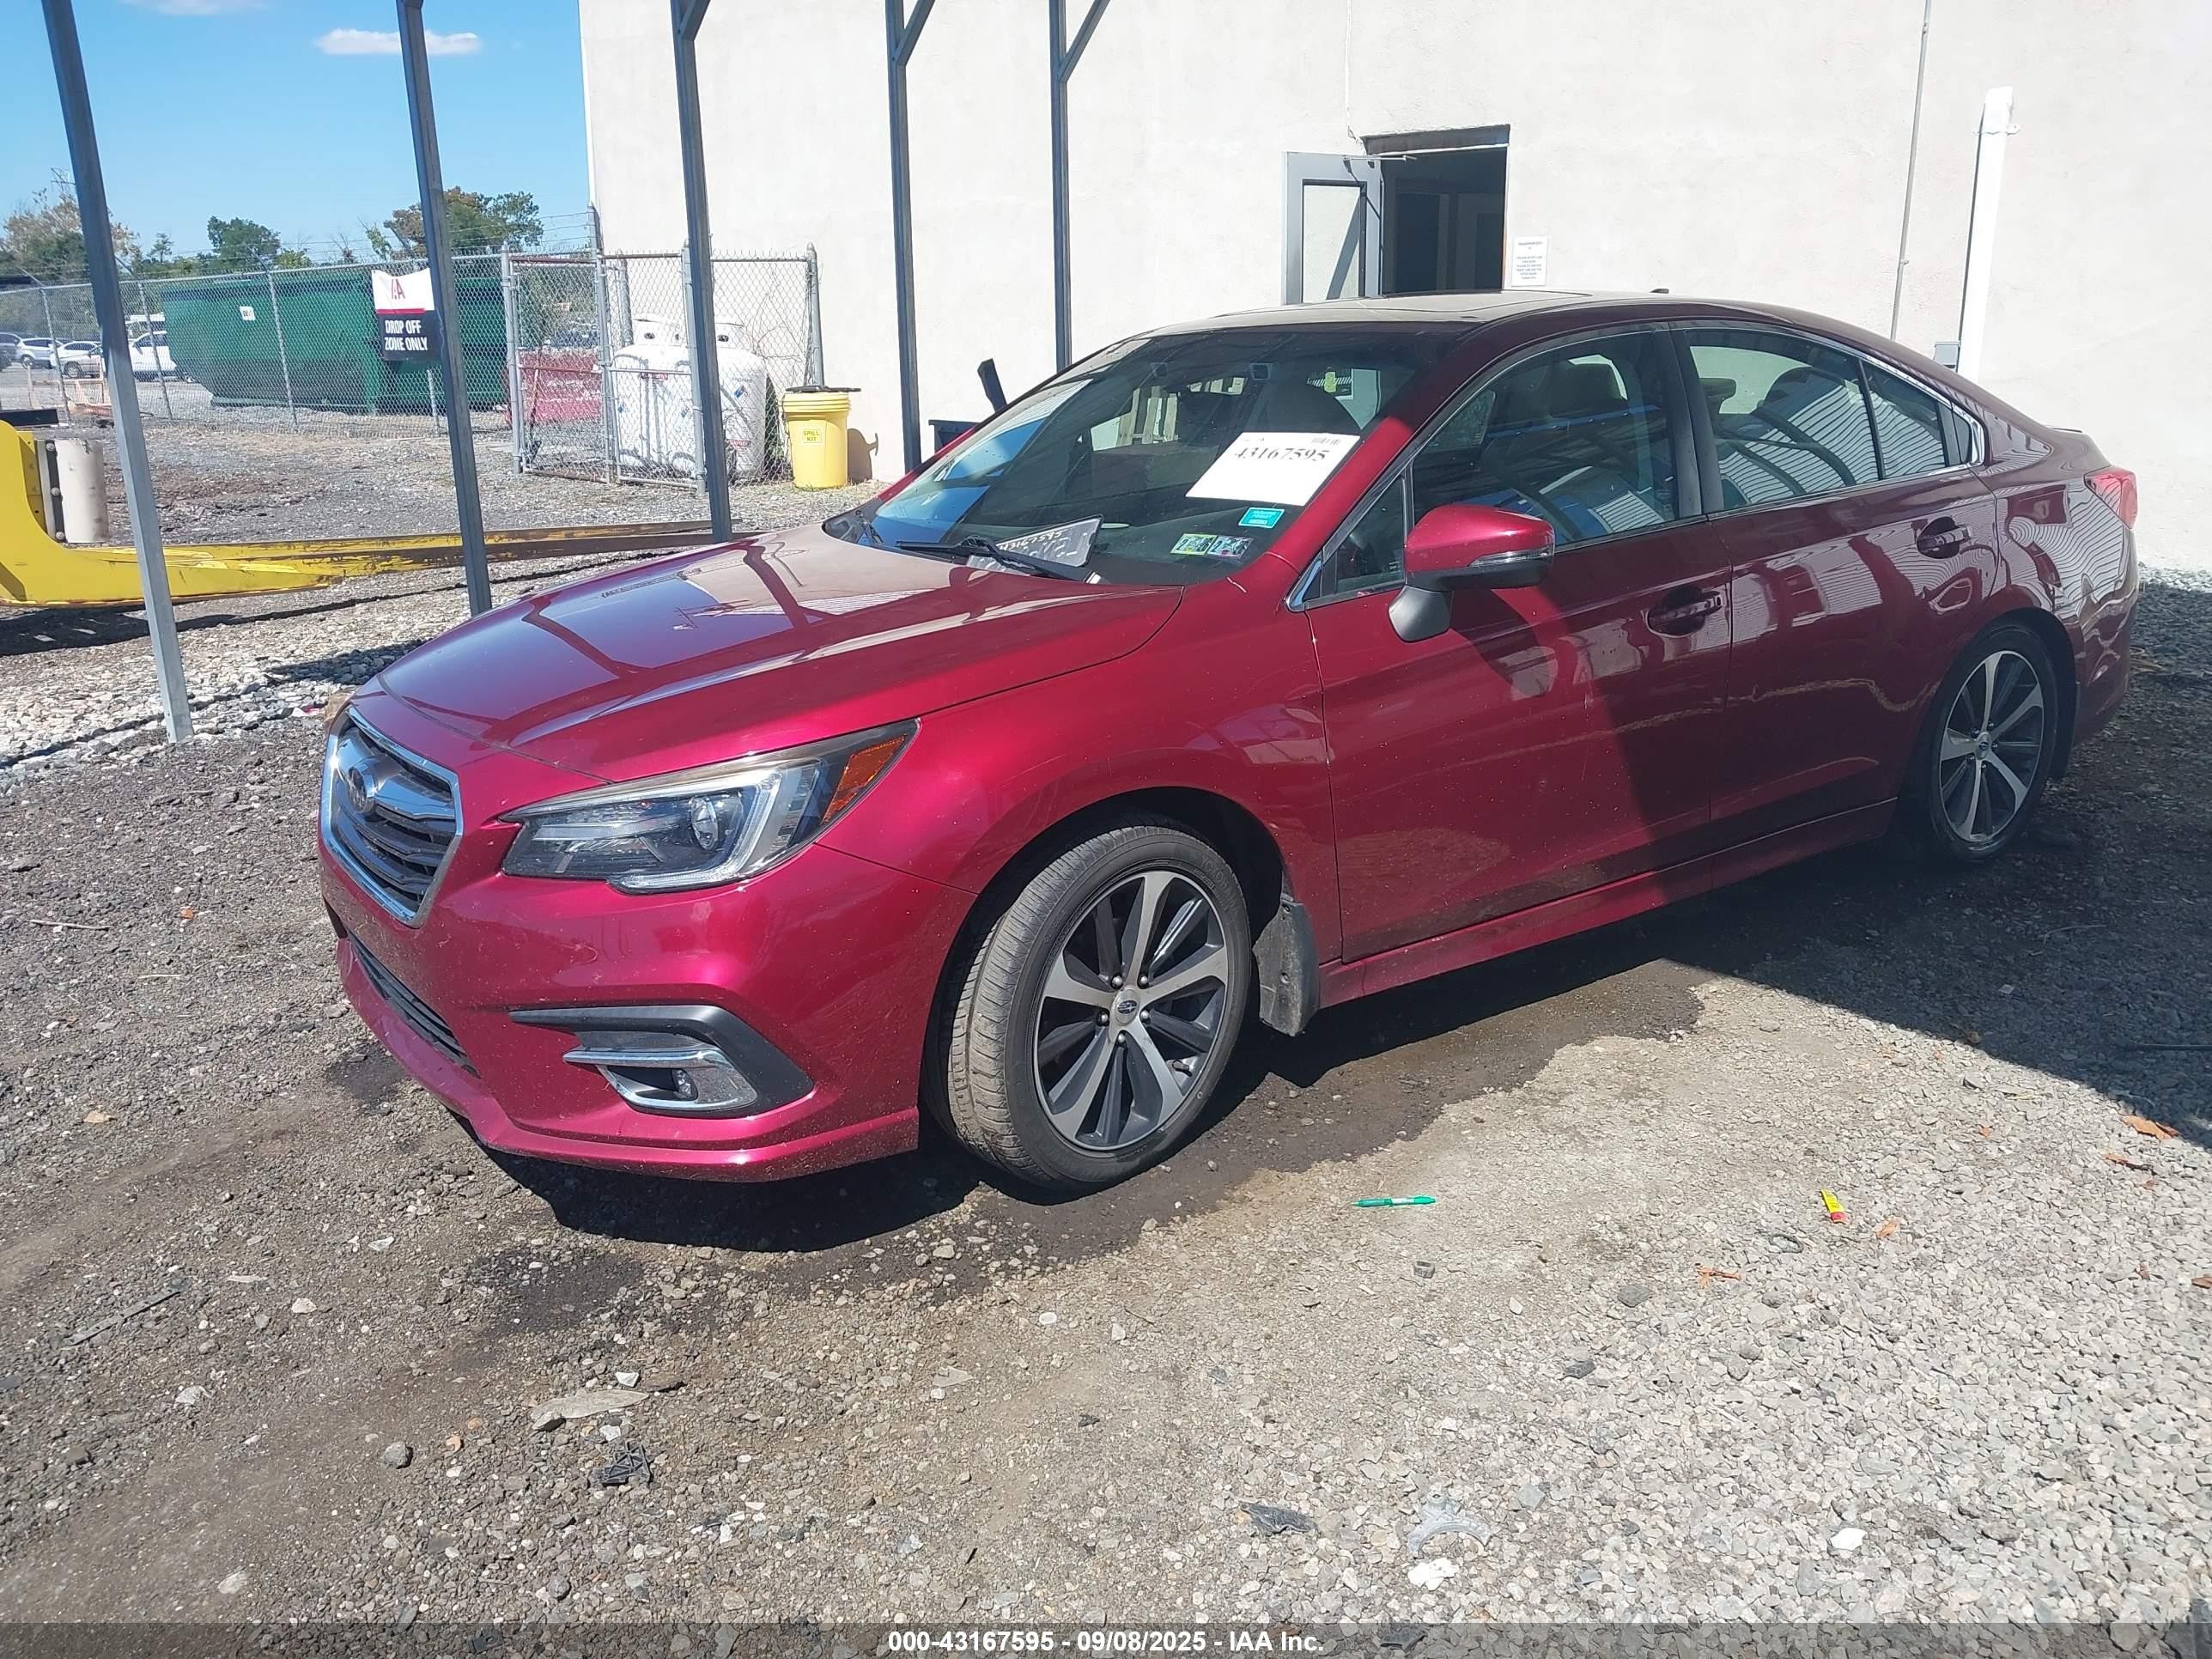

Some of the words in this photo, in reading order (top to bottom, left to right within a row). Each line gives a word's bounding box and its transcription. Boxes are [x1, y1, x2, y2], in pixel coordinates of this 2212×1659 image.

[384, 319, 404, 334] DROP
[405, 319, 422, 334] OFF
[384, 337, 405, 351] ZONE
[405, 337, 428, 351] ONLY
[1235, 447, 1330, 462] 43167595
